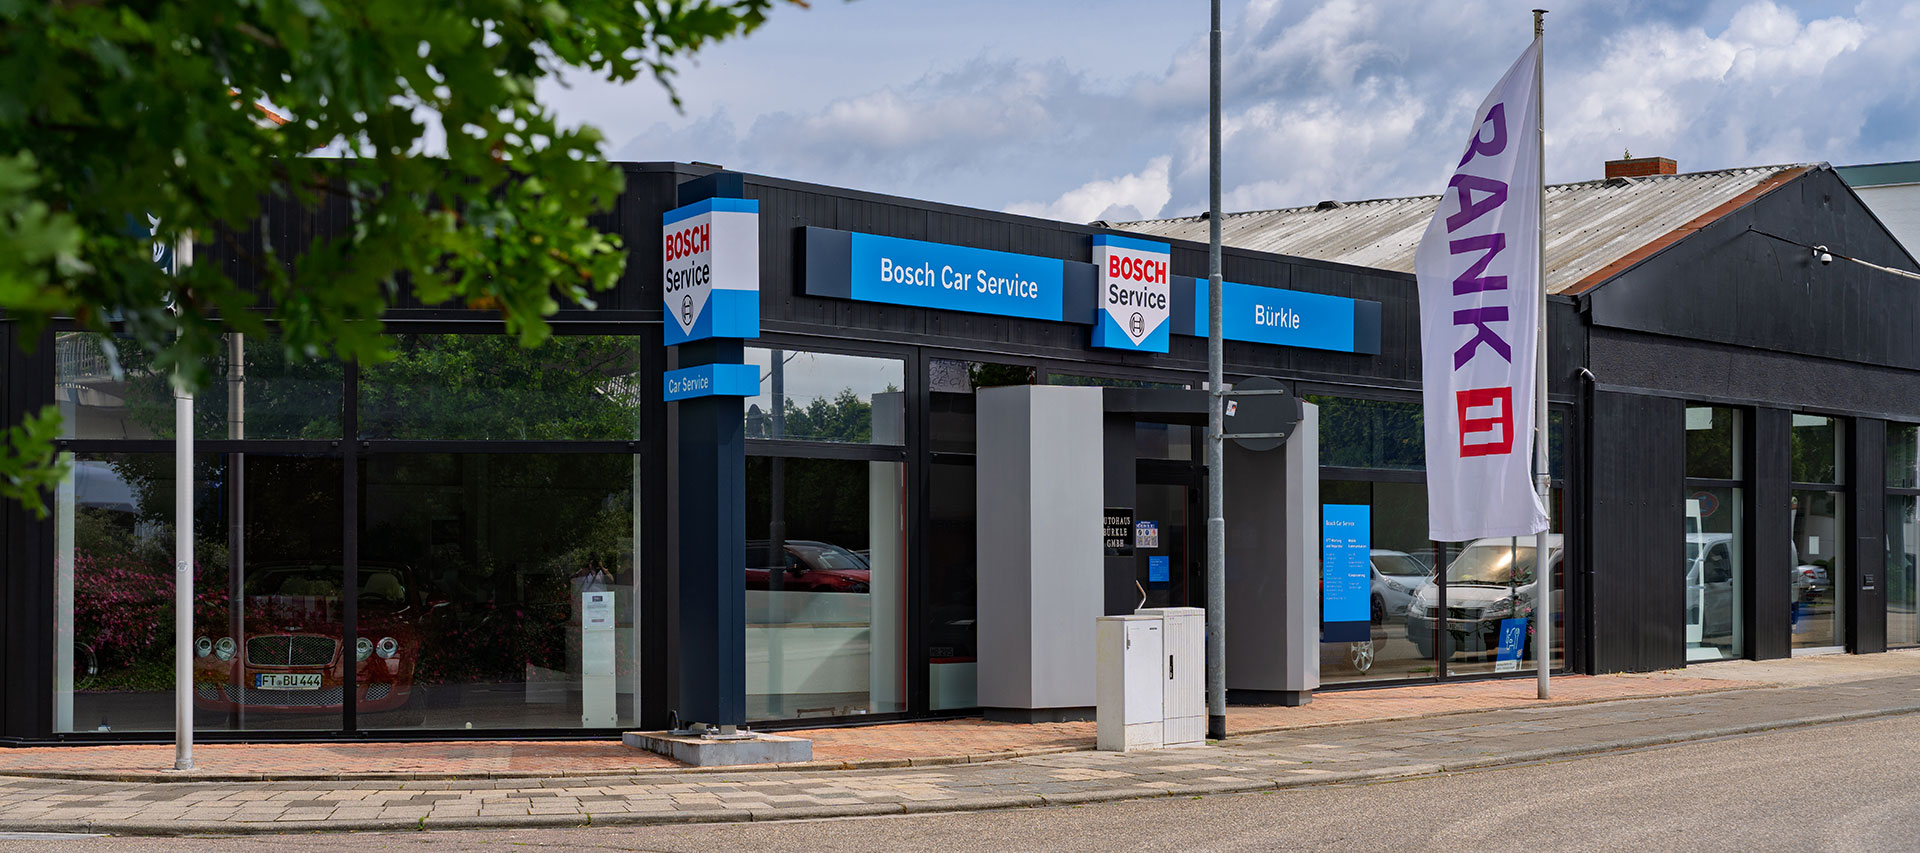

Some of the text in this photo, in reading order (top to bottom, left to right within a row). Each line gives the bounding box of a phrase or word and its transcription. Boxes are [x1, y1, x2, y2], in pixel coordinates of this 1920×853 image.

[665, 223, 710, 262] BOSCH
[666, 260, 709, 293] Service
[880, 256, 1038, 299] Bosch Car Service
[1108, 254, 1168, 285] BOSCH
[1108, 282, 1167, 311] Service
[1254, 304, 1301, 331] Bürkle
[668, 374, 709, 394] Car Service
[1103, 526, 1128, 537] BÜRKLE
[1104, 516, 1130, 525] UTOHAUS
[1106, 539, 1124, 548] GMBH
[262, 675, 320, 686] FT BU 444
